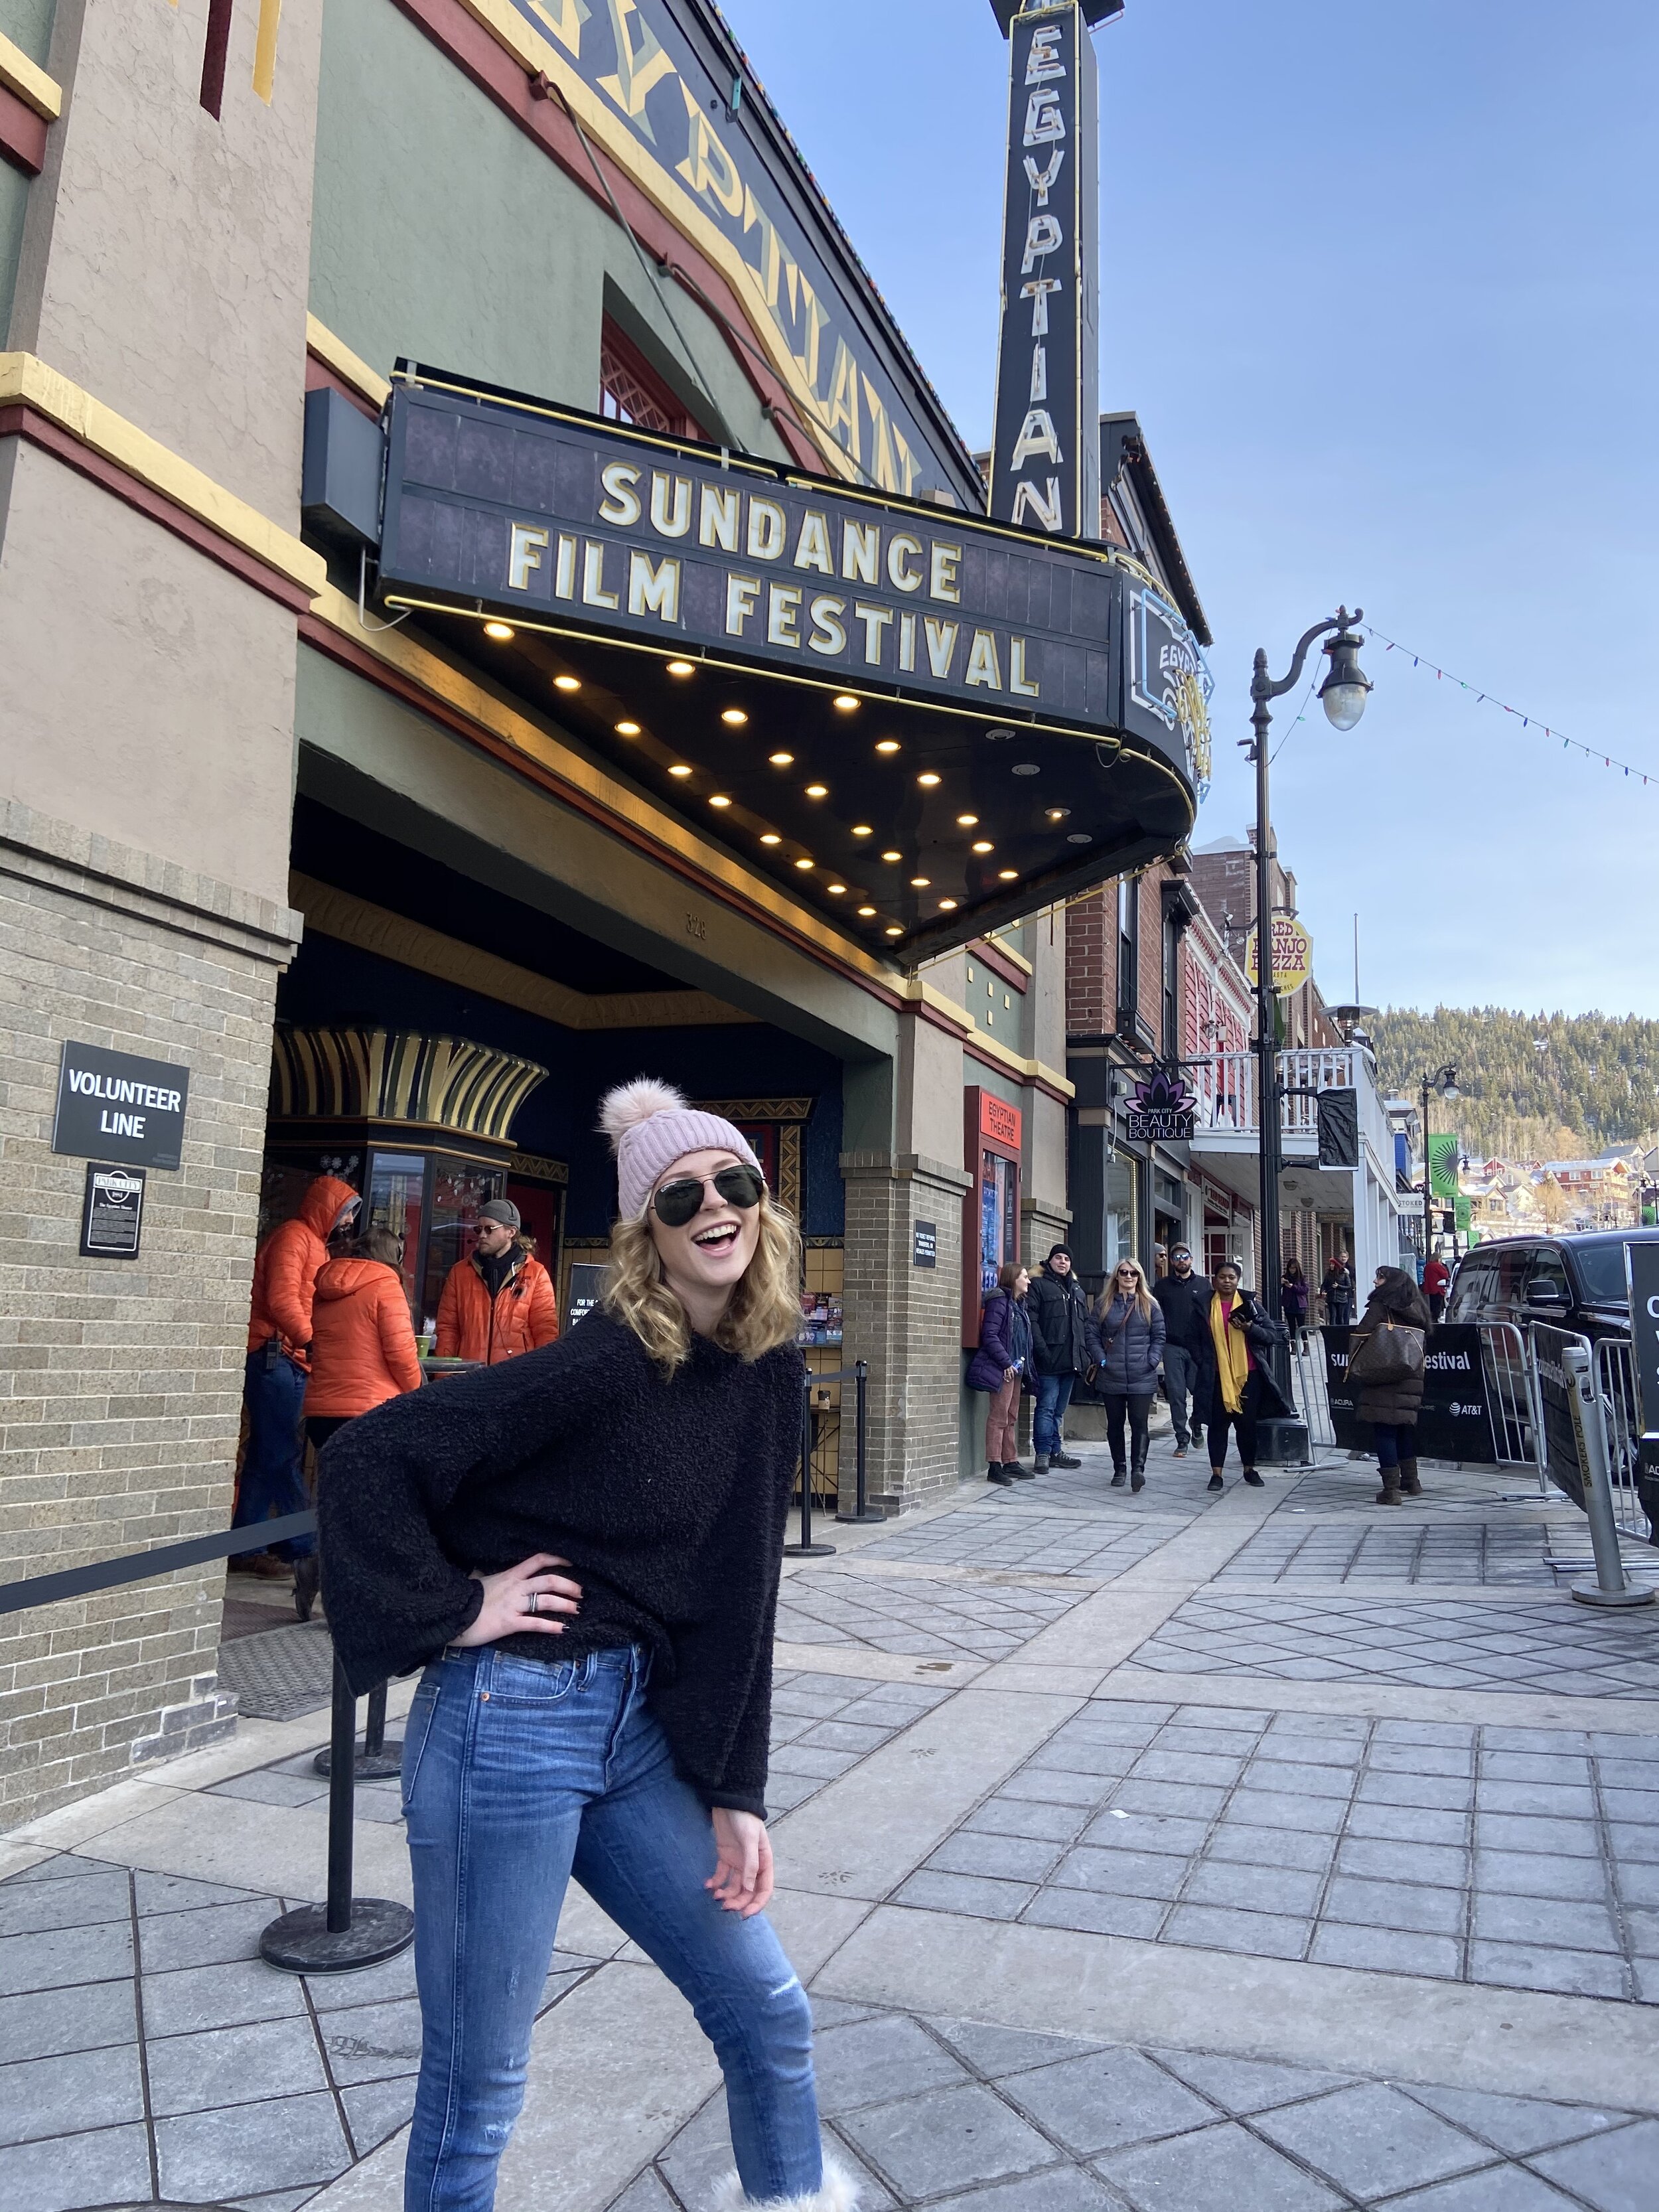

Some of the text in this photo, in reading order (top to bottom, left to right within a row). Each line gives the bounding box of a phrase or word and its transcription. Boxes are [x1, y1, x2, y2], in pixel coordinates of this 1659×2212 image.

[1010, 25, 1066, 531] EGYPTIAN
[598, 461, 962, 603] SUNDANCE
[508, 522, 1040, 698] FILM FESTIVAL
[1271, 921, 1293, 936] RED
[69, 1069, 181, 1112] VOLUNTEER
[101, 1110, 146, 1139] LINE
[989, 1101, 1016, 1126] EGYPTIAN
[1129, 1114, 1192, 1128] BEAUTY
[990, 1118, 1015, 1142] THEATRE
[1129, 1128, 1191, 1138] BOUTIQUE
[98, 1177, 138, 1189] PARK CITY
[1424, 1351, 1471, 1370] estival
[1461, 1405, 1482, 1416] AT&T
[1573, 1415, 1593, 1488] SMOKERS POLE
